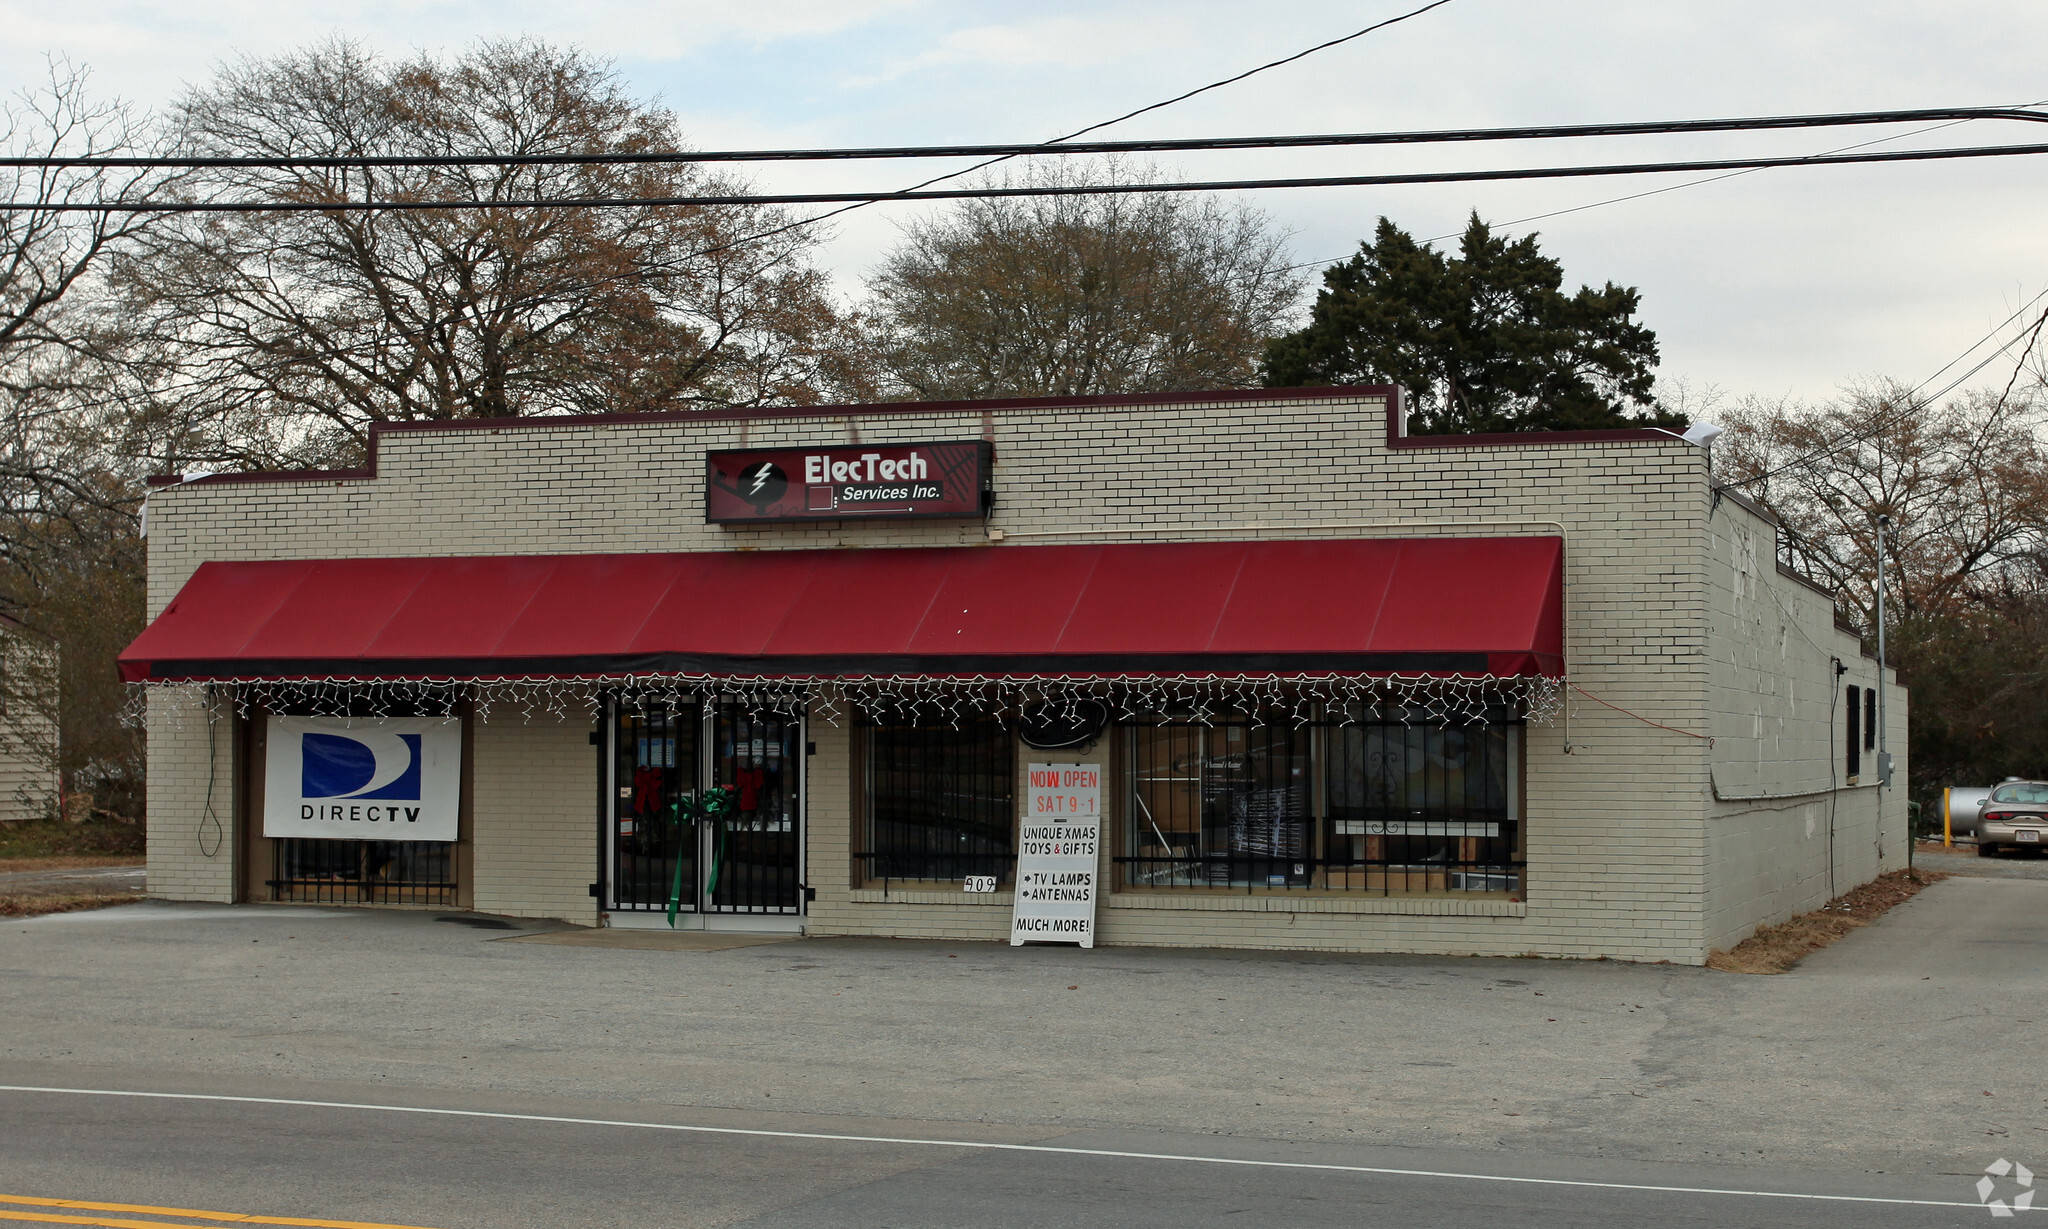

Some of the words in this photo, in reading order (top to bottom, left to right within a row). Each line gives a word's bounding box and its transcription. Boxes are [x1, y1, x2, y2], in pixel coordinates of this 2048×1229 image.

[804, 451, 928, 484] ElecTech
[842, 485, 909, 501] Services
[912, 484, 940, 499] Inc.
[1029, 770, 1060, 788] NOW
[1064, 770, 1098, 788] OPEN
[1037, 795, 1065, 813] SAT
[301, 804, 421, 823] DIRECTV
[1023, 826, 1063, 840] UNIQUE
[1064, 826, 1096, 840] XMAS
[1023, 842, 1051, 855] TOYS
[1054, 843, 1061, 855] &
[1062, 841, 1094, 855] GIFTS
[1033, 872, 1048, 885] TV
[1051, 873, 1091, 886] LAMPS
[1031, 888, 1090, 902] ANTENNAS
[1016, 918, 1050, 932] MUCH
[1052, 919, 1090, 933] MORE!
